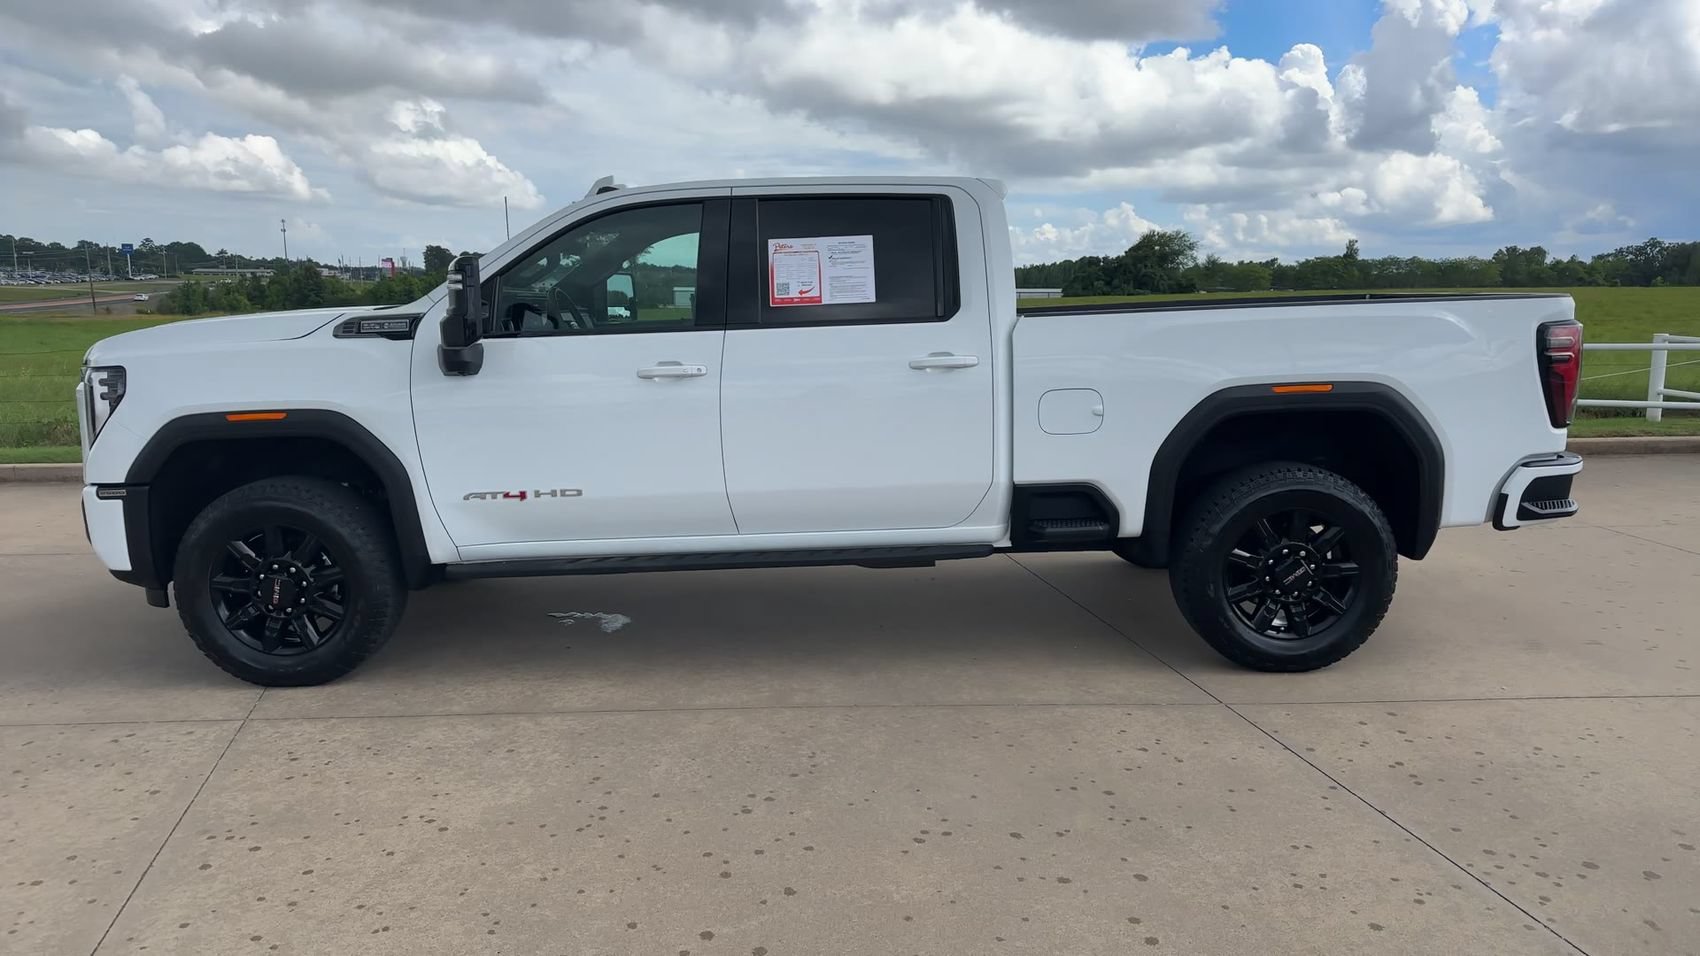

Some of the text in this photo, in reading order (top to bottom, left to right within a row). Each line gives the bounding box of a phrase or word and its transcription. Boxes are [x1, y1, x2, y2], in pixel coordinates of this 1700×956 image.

[463, 488, 583, 501] AT4 HD
[272, 579, 281, 604] GMC
